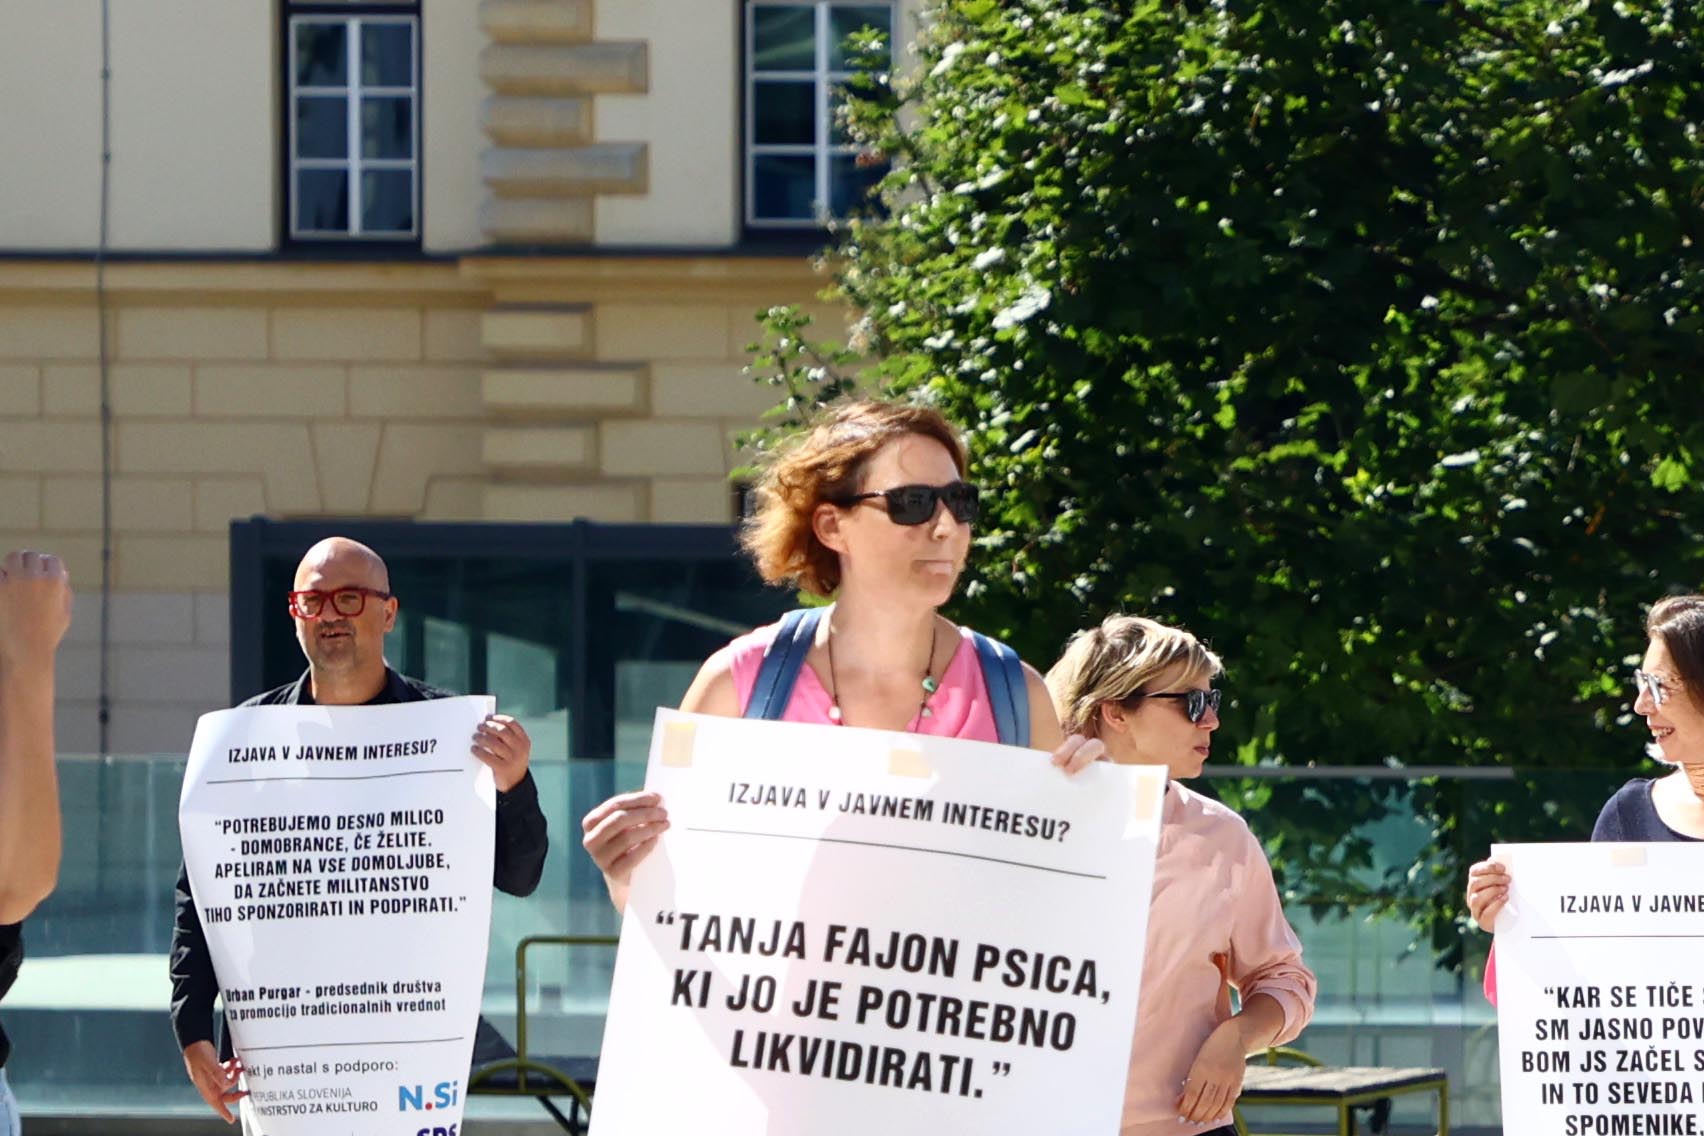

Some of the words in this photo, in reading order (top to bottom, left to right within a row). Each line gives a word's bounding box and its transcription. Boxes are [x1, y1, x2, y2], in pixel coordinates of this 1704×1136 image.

[229, 747, 276, 763] IZJAVA
[282, 746, 290, 760] V
[296, 746, 357, 760] JAVNEM
[364, 739, 437, 760] INTERESU?
[215, 816, 330, 834] “POTREBUJEMO
[337, 812, 384, 830] DESNO
[391, 809, 443, 826] MILICO
[729, 783, 806, 808] IZJAVA
[819, 790, 830, 810] V
[839, 793, 934, 821] JAVNEM
[943, 802, 1070, 842] INTERESU?
[241, 837, 348, 855] DOMOBRANCE,
[354, 833, 371, 850] ČE
[377, 831, 431, 848] ŽELITE.
[215, 860, 287, 880] APELIRAM
[293, 859, 312, 874] NA
[319, 858, 346, 873] VSE
[352, 853, 449, 871] DOMOLJUBE,
[235, 883, 253, 899] DA
[259, 879, 320, 898] ZAČNETE
[327, 876, 428, 894] MILITANSTVO
[204, 907, 231, 923] TIHO
[238, 901, 342, 921] SPONZORIRATI
[349, 900, 364, 915] IN
[1561, 895, 1624, 913] IZJAVA
[1632, 895, 1641, 912] V
[656, 911, 805, 960] “TANJA
[824, 925, 959, 978] FAJON
[973, 944, 1109, 1004] PSICA,
[259, 987, 300, 1000] Purgar
[316, 982, 387, 998] predsednik
[393, 981, 441, 994] društva
[1545, 986, 1600, 1008] “KAR
[1611, 986, 1636, 1007] SE
[1646, 982, 1693, 1007] TIČE
[240, 1004, 296, 1021] promocijo
[301, 1000, 391, 1016] tradicionalnih
[397, 999, 445, 1012] vrednot
[672, 969, 712, 1008] KI
[726, 975, 776, 1013] JO
[792, 980, 842, 1021] JE
[856, 986, 1076, 1051] POTREBNO
[1536, 1019, 1568, 1040] SM
[1579, 1018, 1652, 1040] JASNO
[262, 1065, 273, 1080] je
[278, 1062, 316, 1075] nastal
[322, 1064, 329, 1073] s
[335, 1060, 398, 1075] podporo:
[731, 1030, 1010, 1098] LIKVIDIRATI.”
[1522, 1051, 1570, 1072] BOM
[1580, 1050, 1606, 1072] JS
[1616, 1046, 1684, 1072] ZAČEL
[297, 1088, 352, 1100] SLOVENIJA
[1542, 1083, 1563, 1104] IN
[1573, 1082, 1598, 1104] TO
[1608, 1082, 1693, 1104] SEVEDA
[310, 1104, 323, 1113] ZA
[326, 1101, 377, 1112] KULTURO
